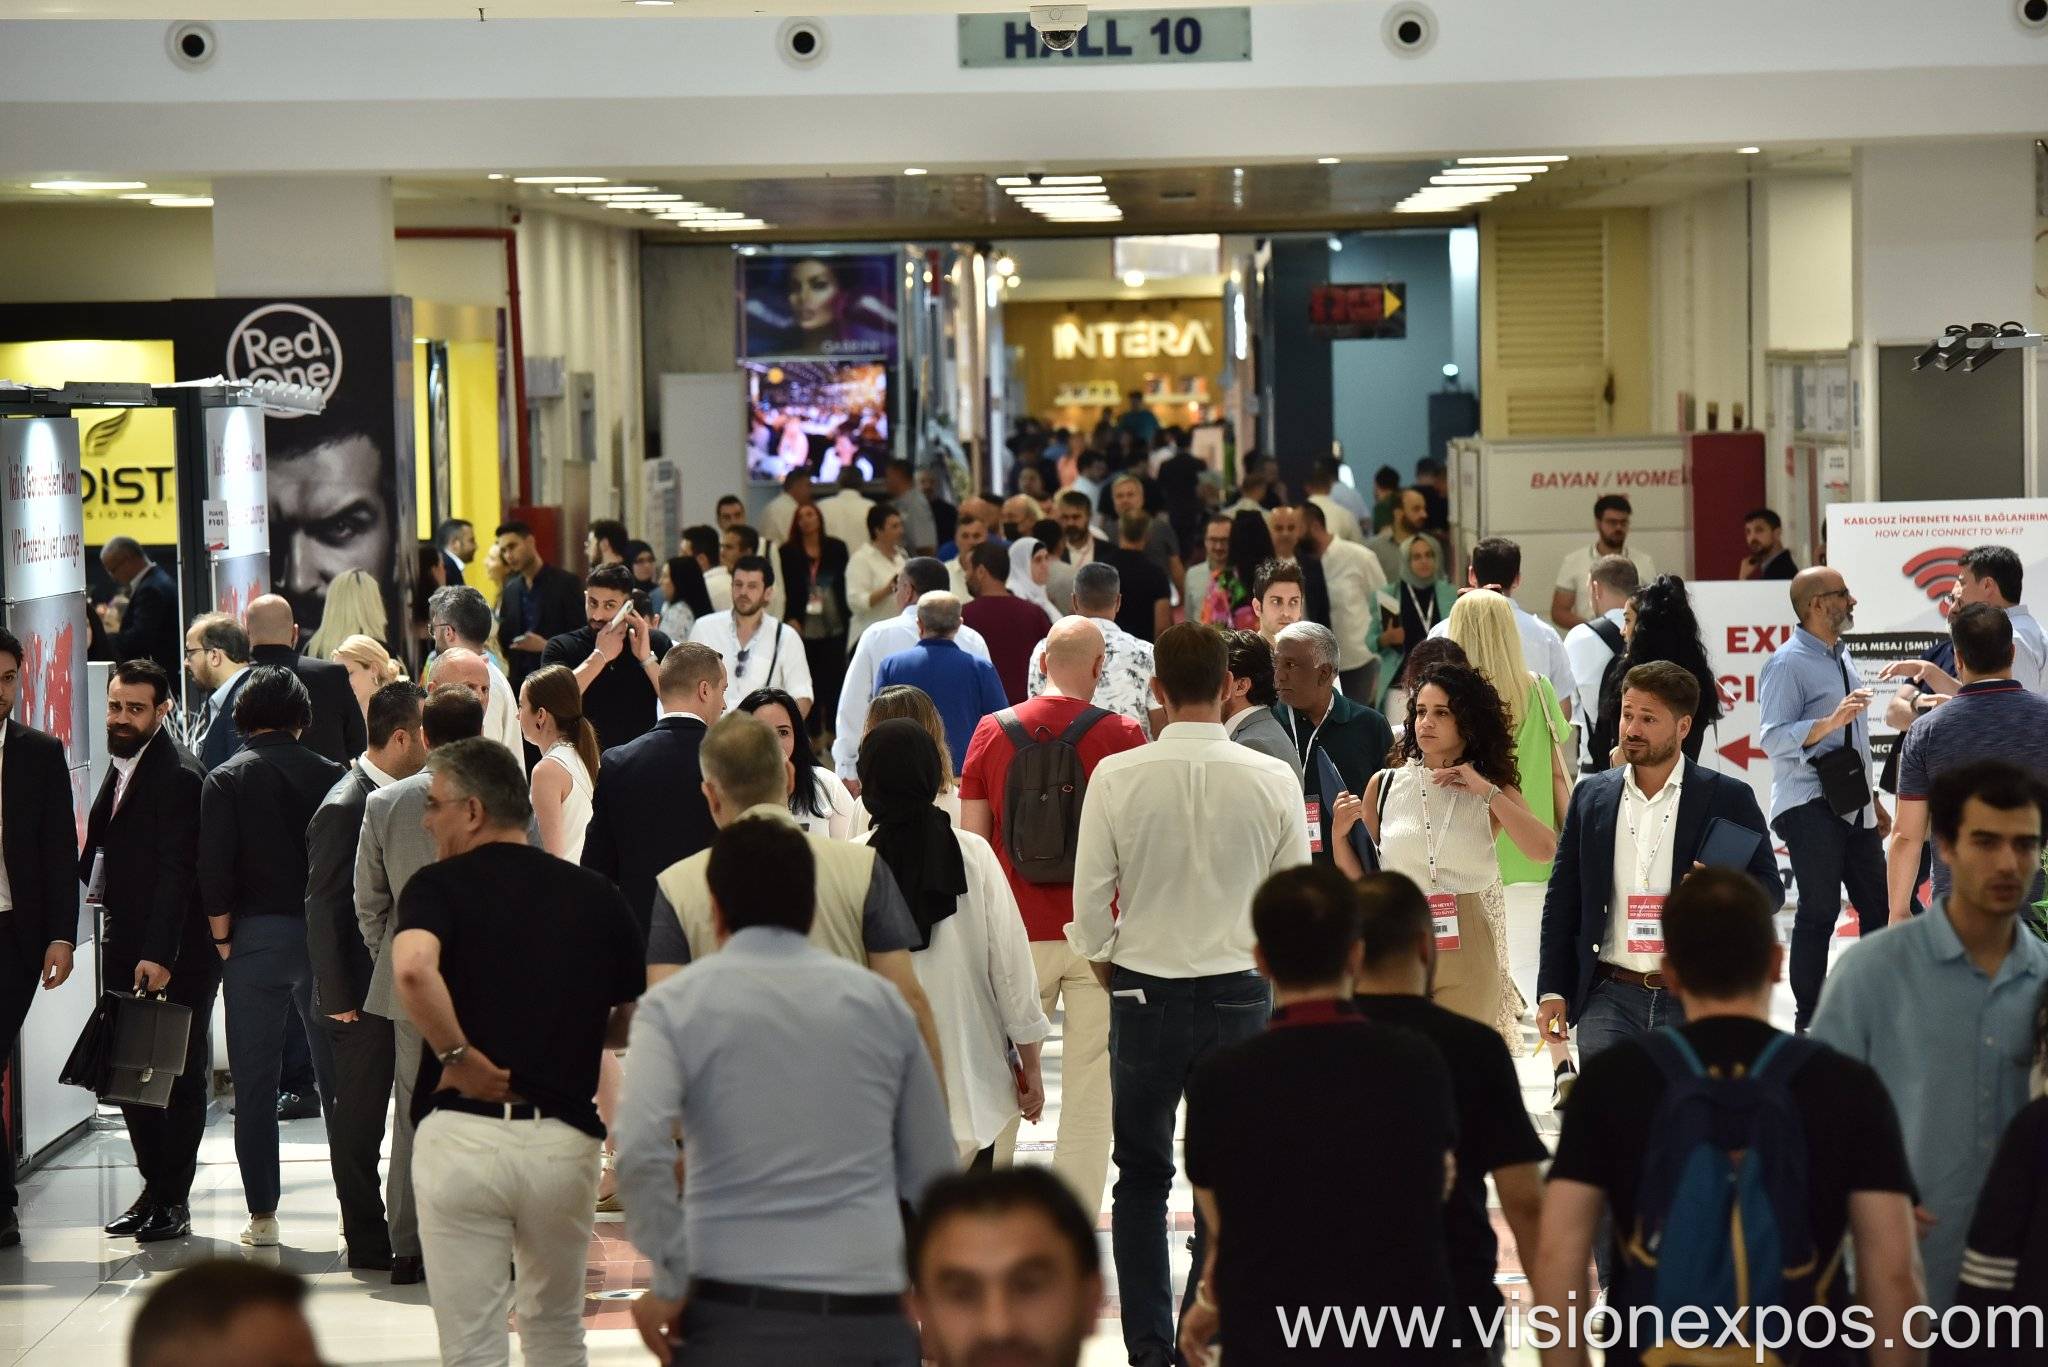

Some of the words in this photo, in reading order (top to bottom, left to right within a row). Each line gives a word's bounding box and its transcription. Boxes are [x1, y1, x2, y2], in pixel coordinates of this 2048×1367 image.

[1150, 17, 1202, 55] 10
[242, 322, 322, 369] Red
[1053, 320, 1214, 360] INTERA
[1530, 471, 1599, 489] BAYAN
[1844, 516, 1896, 525] KABLOSUZ
[1899, 514, 1950, 524] İNTERNETE
[1953, 513, 1981, 523] NASIL
[1875, 530, 1899, 538] HOW
[1902, 529, 1924, 537] CAN
[1931, 528, 1977, 537] CONNECT
[1980, 528, 1992, 536] TO
[1727, 626, 1794, 654] EXI
[1846, 642, 1867, 651] KISA
[1870, 641, 1903, 652] MESAJ
